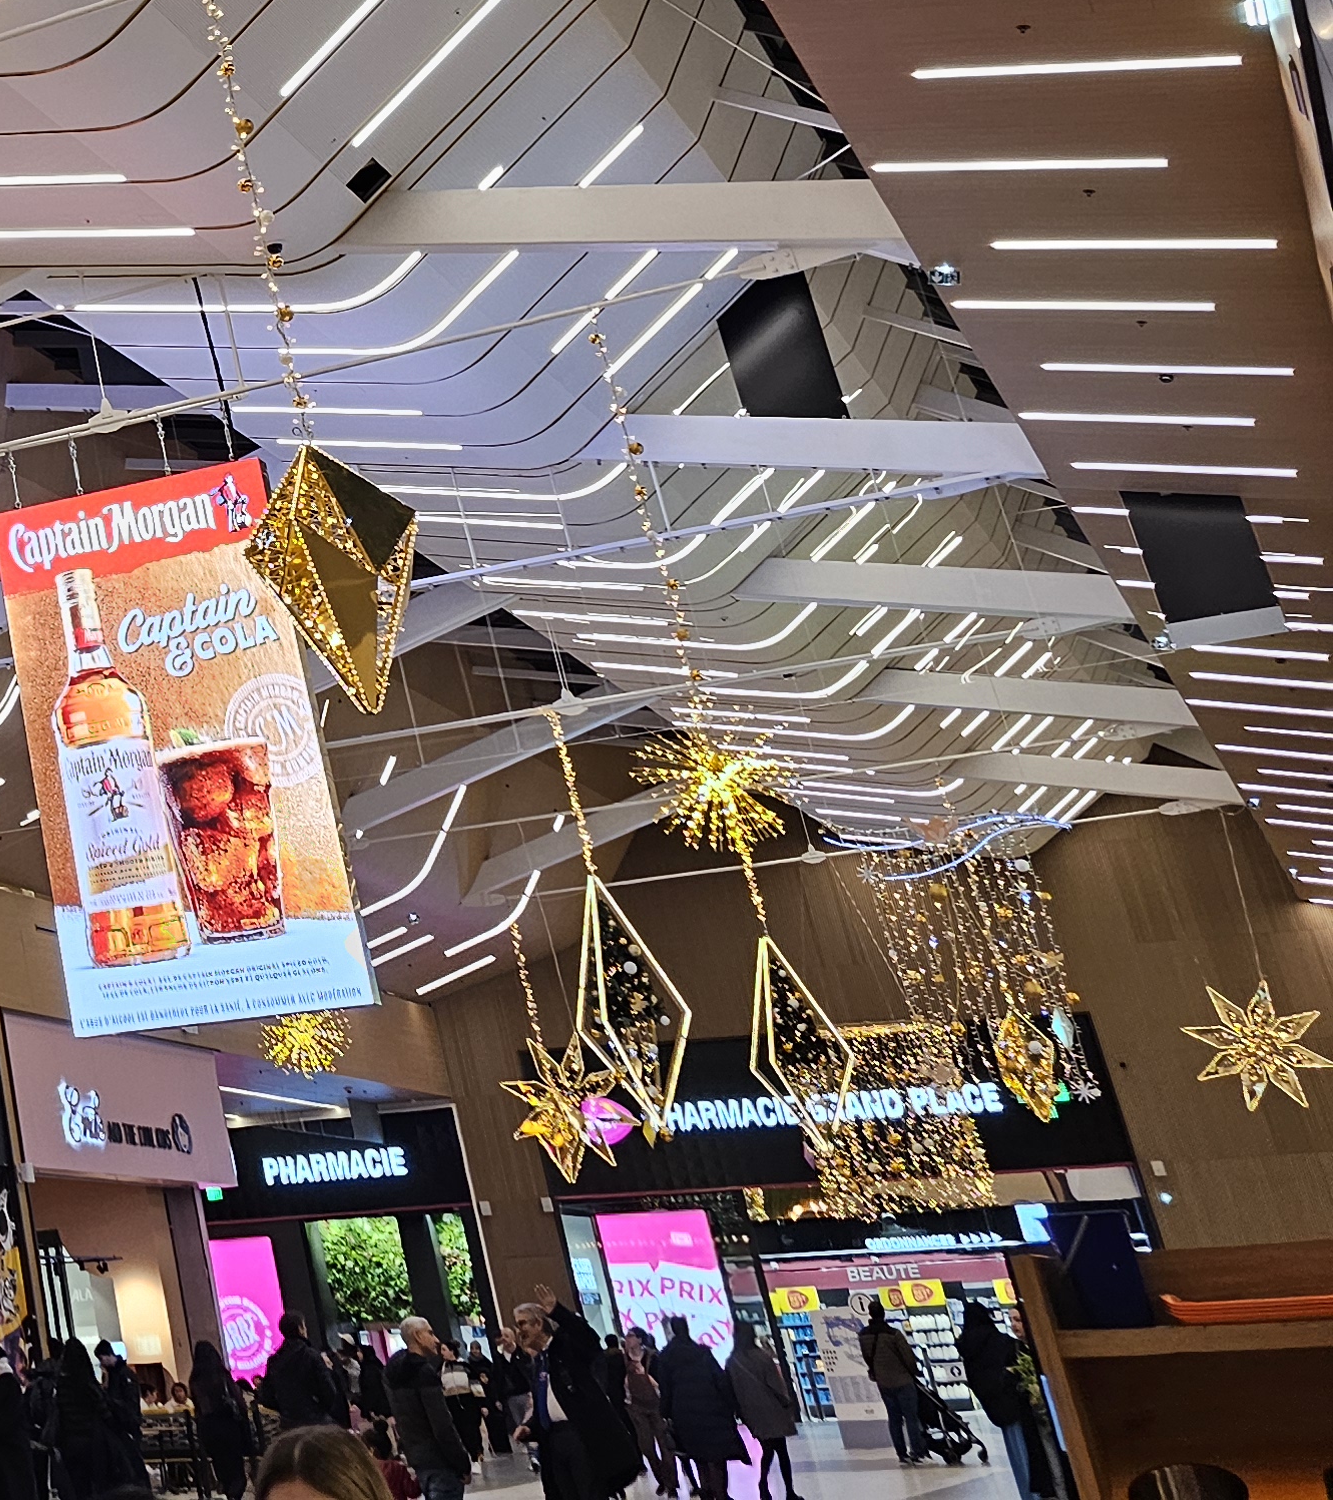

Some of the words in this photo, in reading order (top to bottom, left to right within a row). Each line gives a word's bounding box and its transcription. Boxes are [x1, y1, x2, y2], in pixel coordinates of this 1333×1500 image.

[8, 510, 109, 572] Captain
[103, 493, 216, 554] Morgan
[117, 583, 257, 654] Captain
[193, 615, 280, 661] COLA
[261, 1146, 409, 1187] PHARMACIE
[659, 1276, 726, 1307] PRIX
[846, 1263, 922, 1283] BEAUTE
